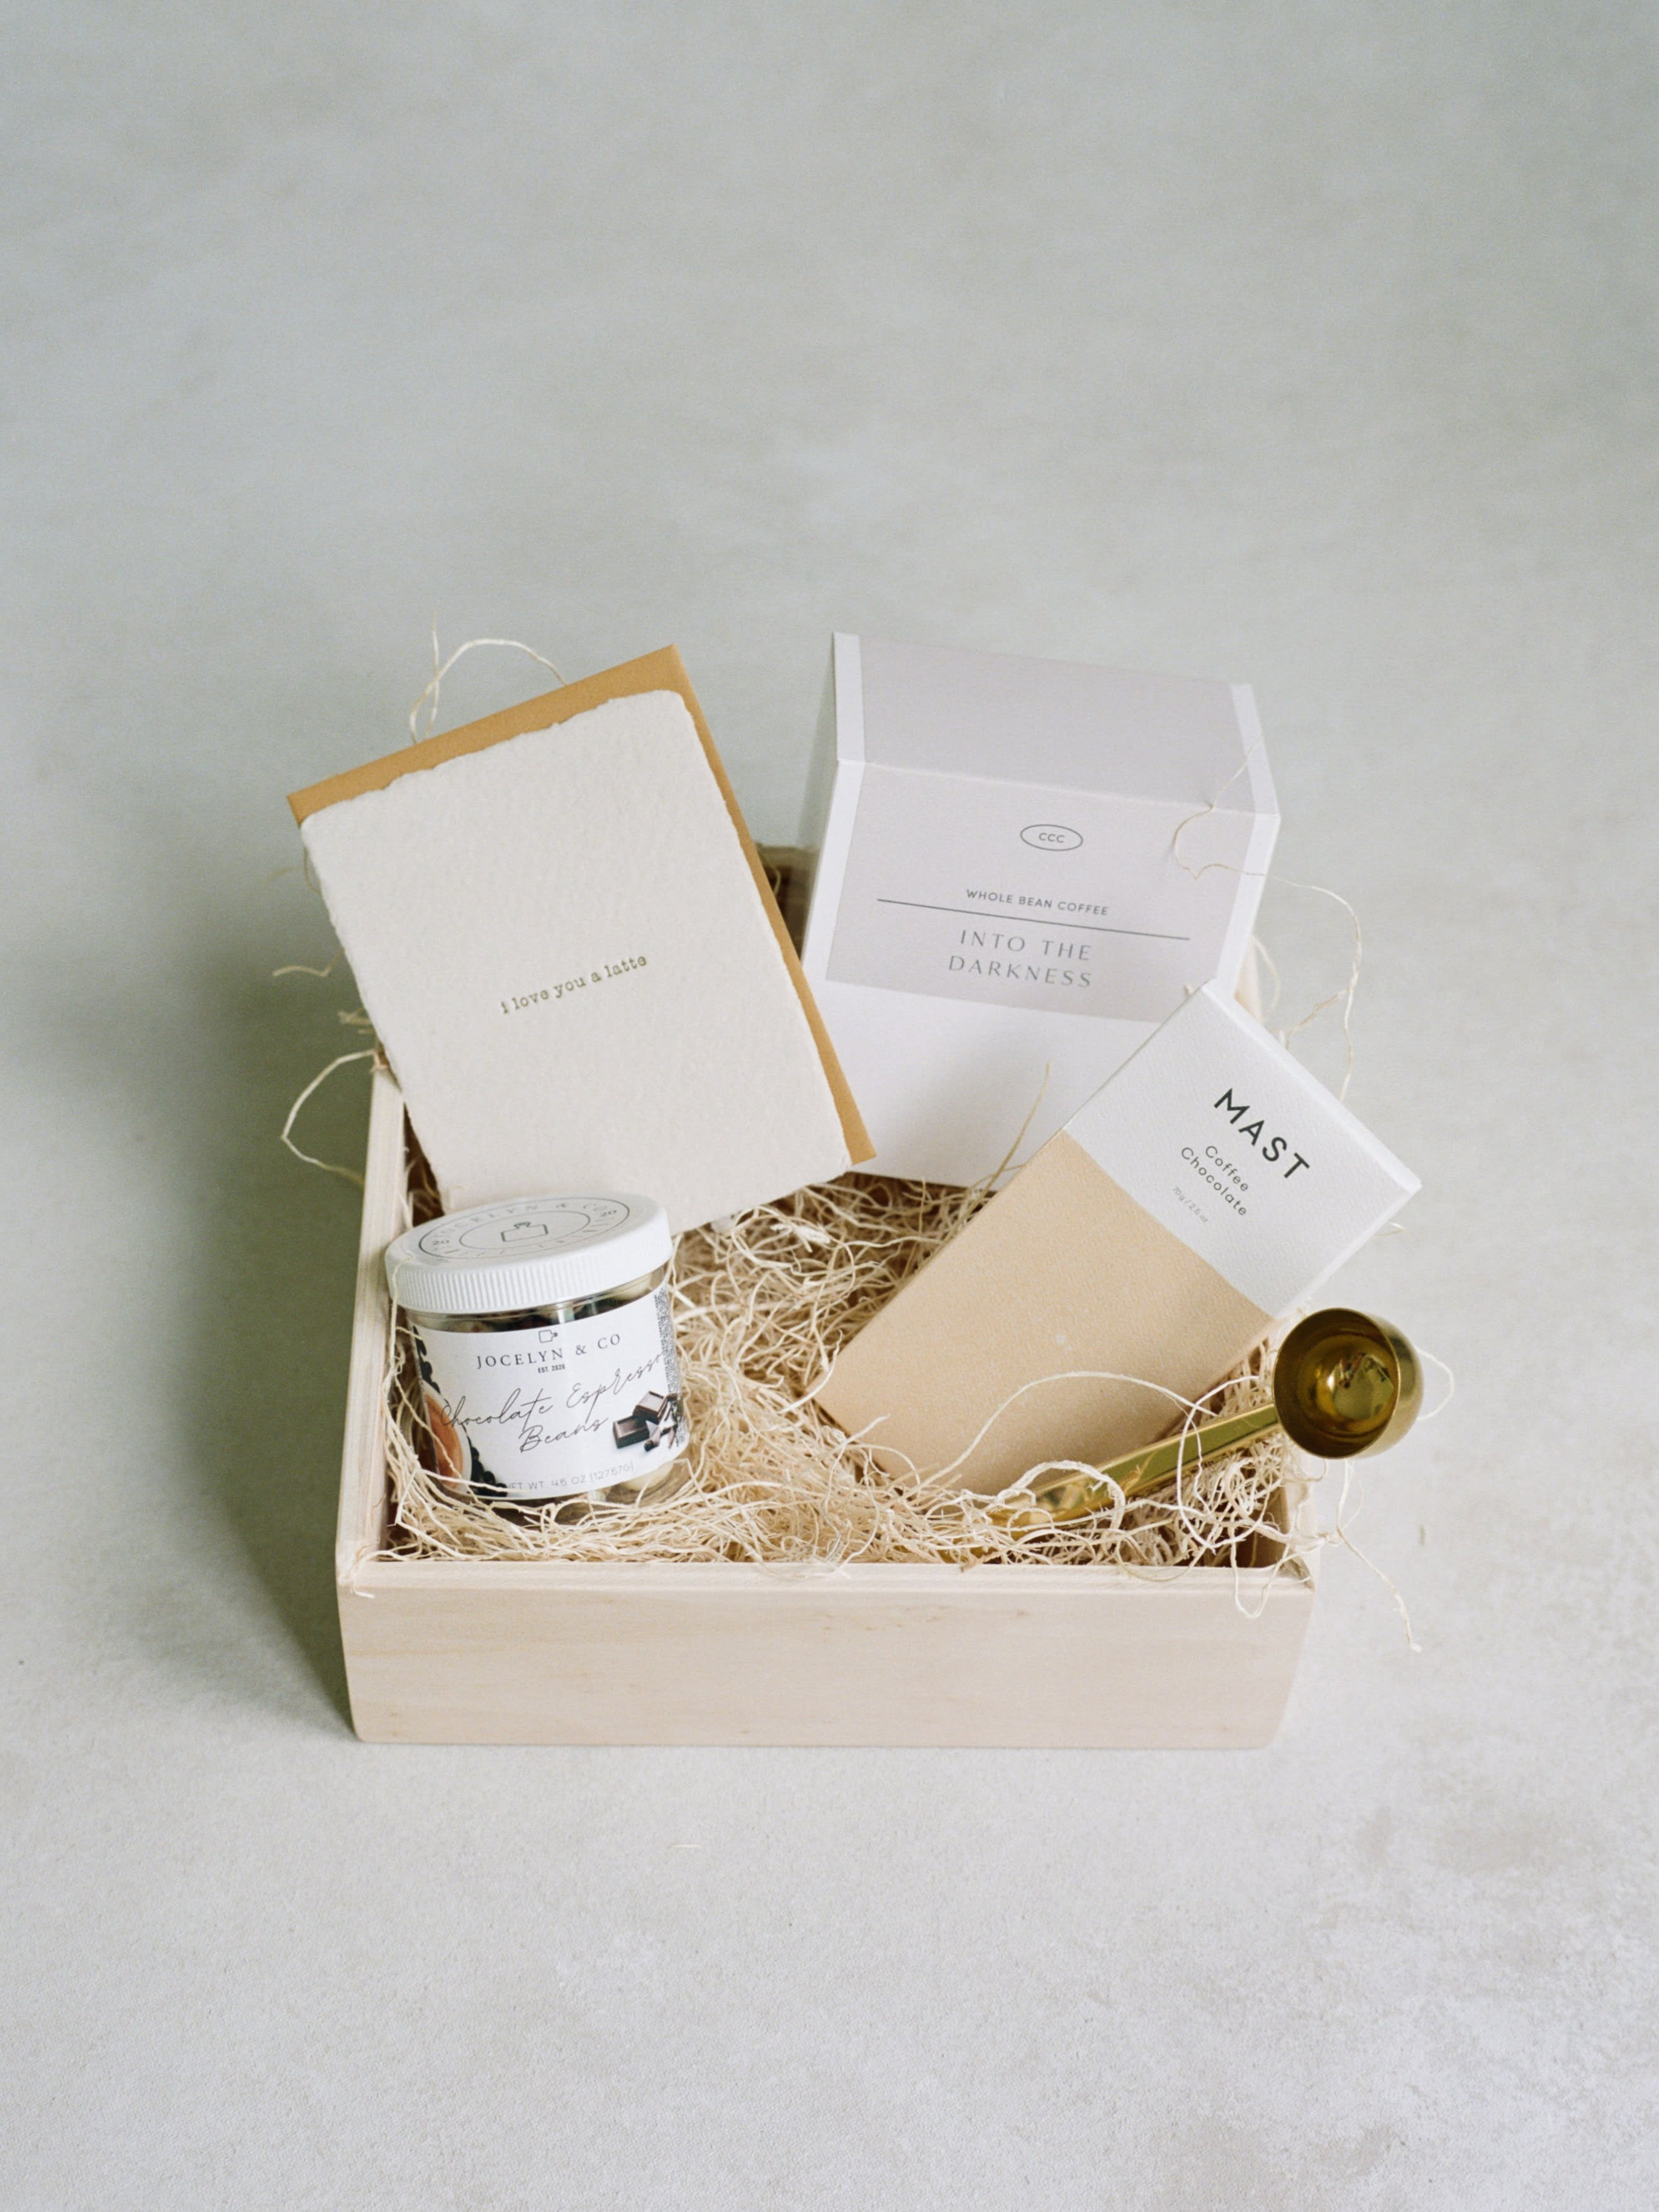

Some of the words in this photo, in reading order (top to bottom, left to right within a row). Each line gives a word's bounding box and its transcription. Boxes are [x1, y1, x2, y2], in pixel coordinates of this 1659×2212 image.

[1039, 832, 1065, 844] CCC
[966, 889, 1013, 904] WHOLE
[1018, 897, 1053, 909] BEAN
[1058, 901, 1109, 916] COFFEE
[960, 929, 1026, 952] INTO
[1042, 940, 1092, 961] THE
[511, 990, 549, 1010] love
[553, 976, 586, 998] you
[591, 971, 601, 983] a
[604, 956, 647, 978] latte
[949, 956, 1093, 988] DARKNESS
[1214, 1087, 1310, 1179] MAST
[1181, 1147, 1248, 1216] Chocolate
[1205, 1145, 1249, 1192] Coffee
[477, 1348, 564, 1369] JOCELYN
[575, 1344, 587, 1356] &
[598, 1333, 620, 1349] CO
[552, 1363, 566, 1371] 2020
[441, 1387, 554, 1432] Chocolate
[518, 1416, 609, 1453] Beans
[528, 1480, 544, 1489] WT
[571, 1474, 586, 1484] OZ
